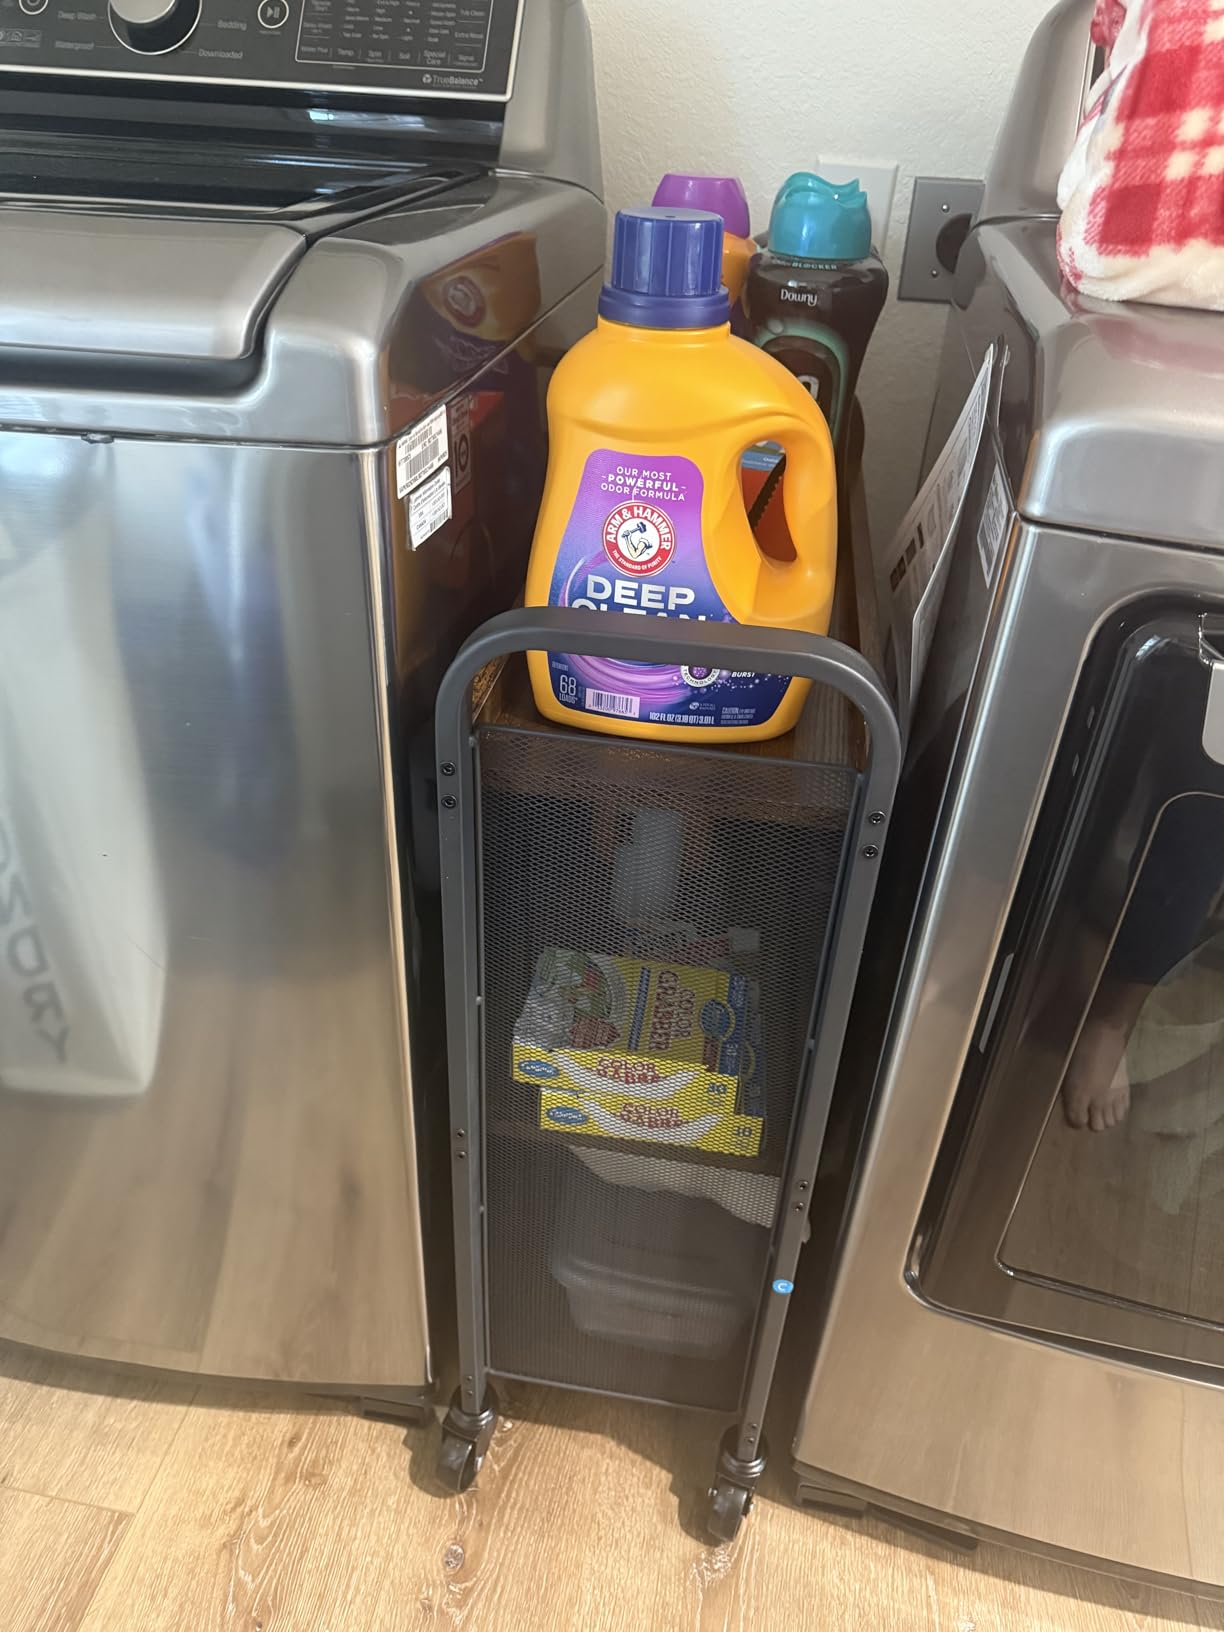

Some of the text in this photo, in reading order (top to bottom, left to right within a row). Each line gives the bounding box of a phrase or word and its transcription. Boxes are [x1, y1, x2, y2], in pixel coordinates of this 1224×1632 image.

[198, 48, 243, 59] Downloaded
[780, 288, 818, 307] Downy
[616, 466, 672, 481] OUR MOST
[608, 474, 679, 491] POWERFUL
[600, 483, 685, 501] ODOR FORMULA
[606, 506, 672, 550] ARM & HAMMER
[618, 556, 642, 571] STANDARD
[648, 556, 663, 570] PURITY
[586, 574, 696, 611] DEEP
[560, 674, 577, 696] 68
[682, 668, 718, 685] TECHNOLOGY
[649, 711, 660, 721] 102
[660, 713, 667, 721] FL
[667, 713, 675, 722] OZ
